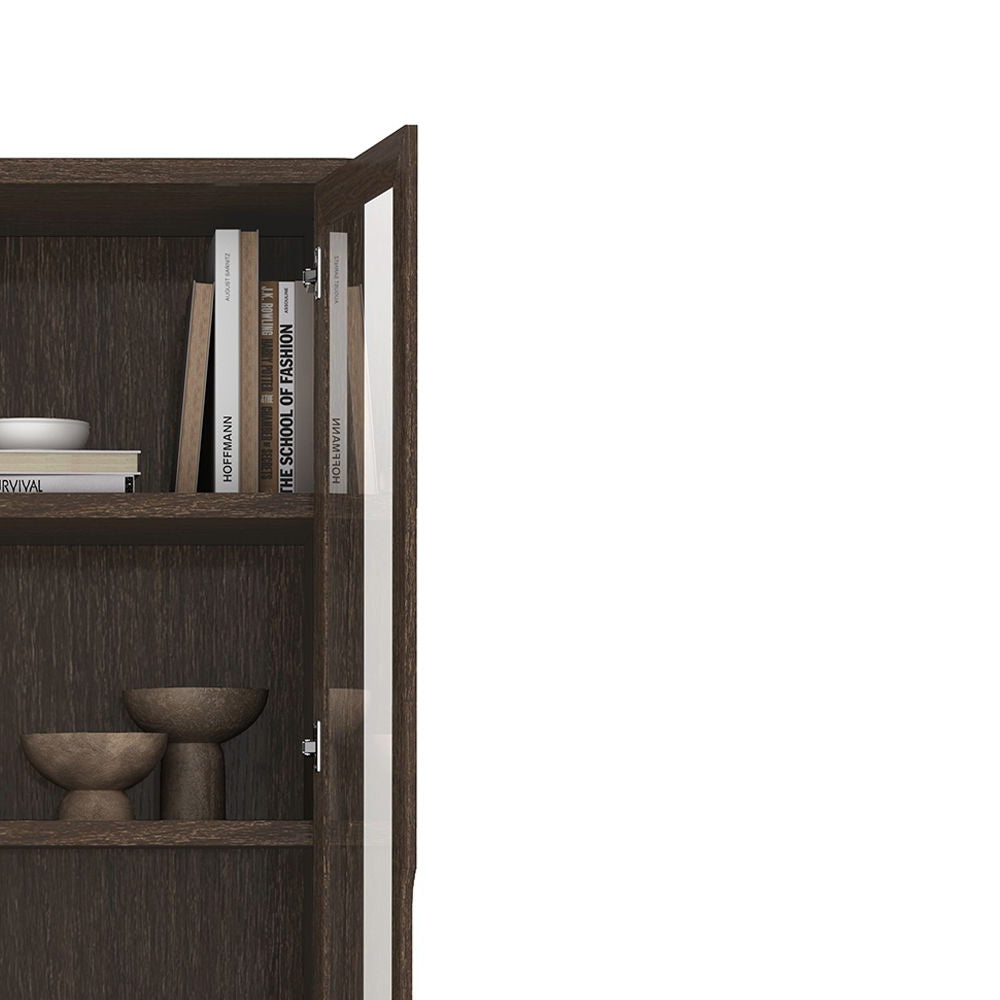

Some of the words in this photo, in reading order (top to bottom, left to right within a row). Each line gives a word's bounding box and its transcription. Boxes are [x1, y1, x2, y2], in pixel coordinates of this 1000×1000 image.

[260, 302, 274, 336] ROWLING
[280, 324, 293, 384] FASHION
[280, 387, 293, 406] OF
[223, 416, 232, 482] HOFFMANN
[280, 410, 293, 466] SCHOOL
[280, 468, 293, 493] THE
